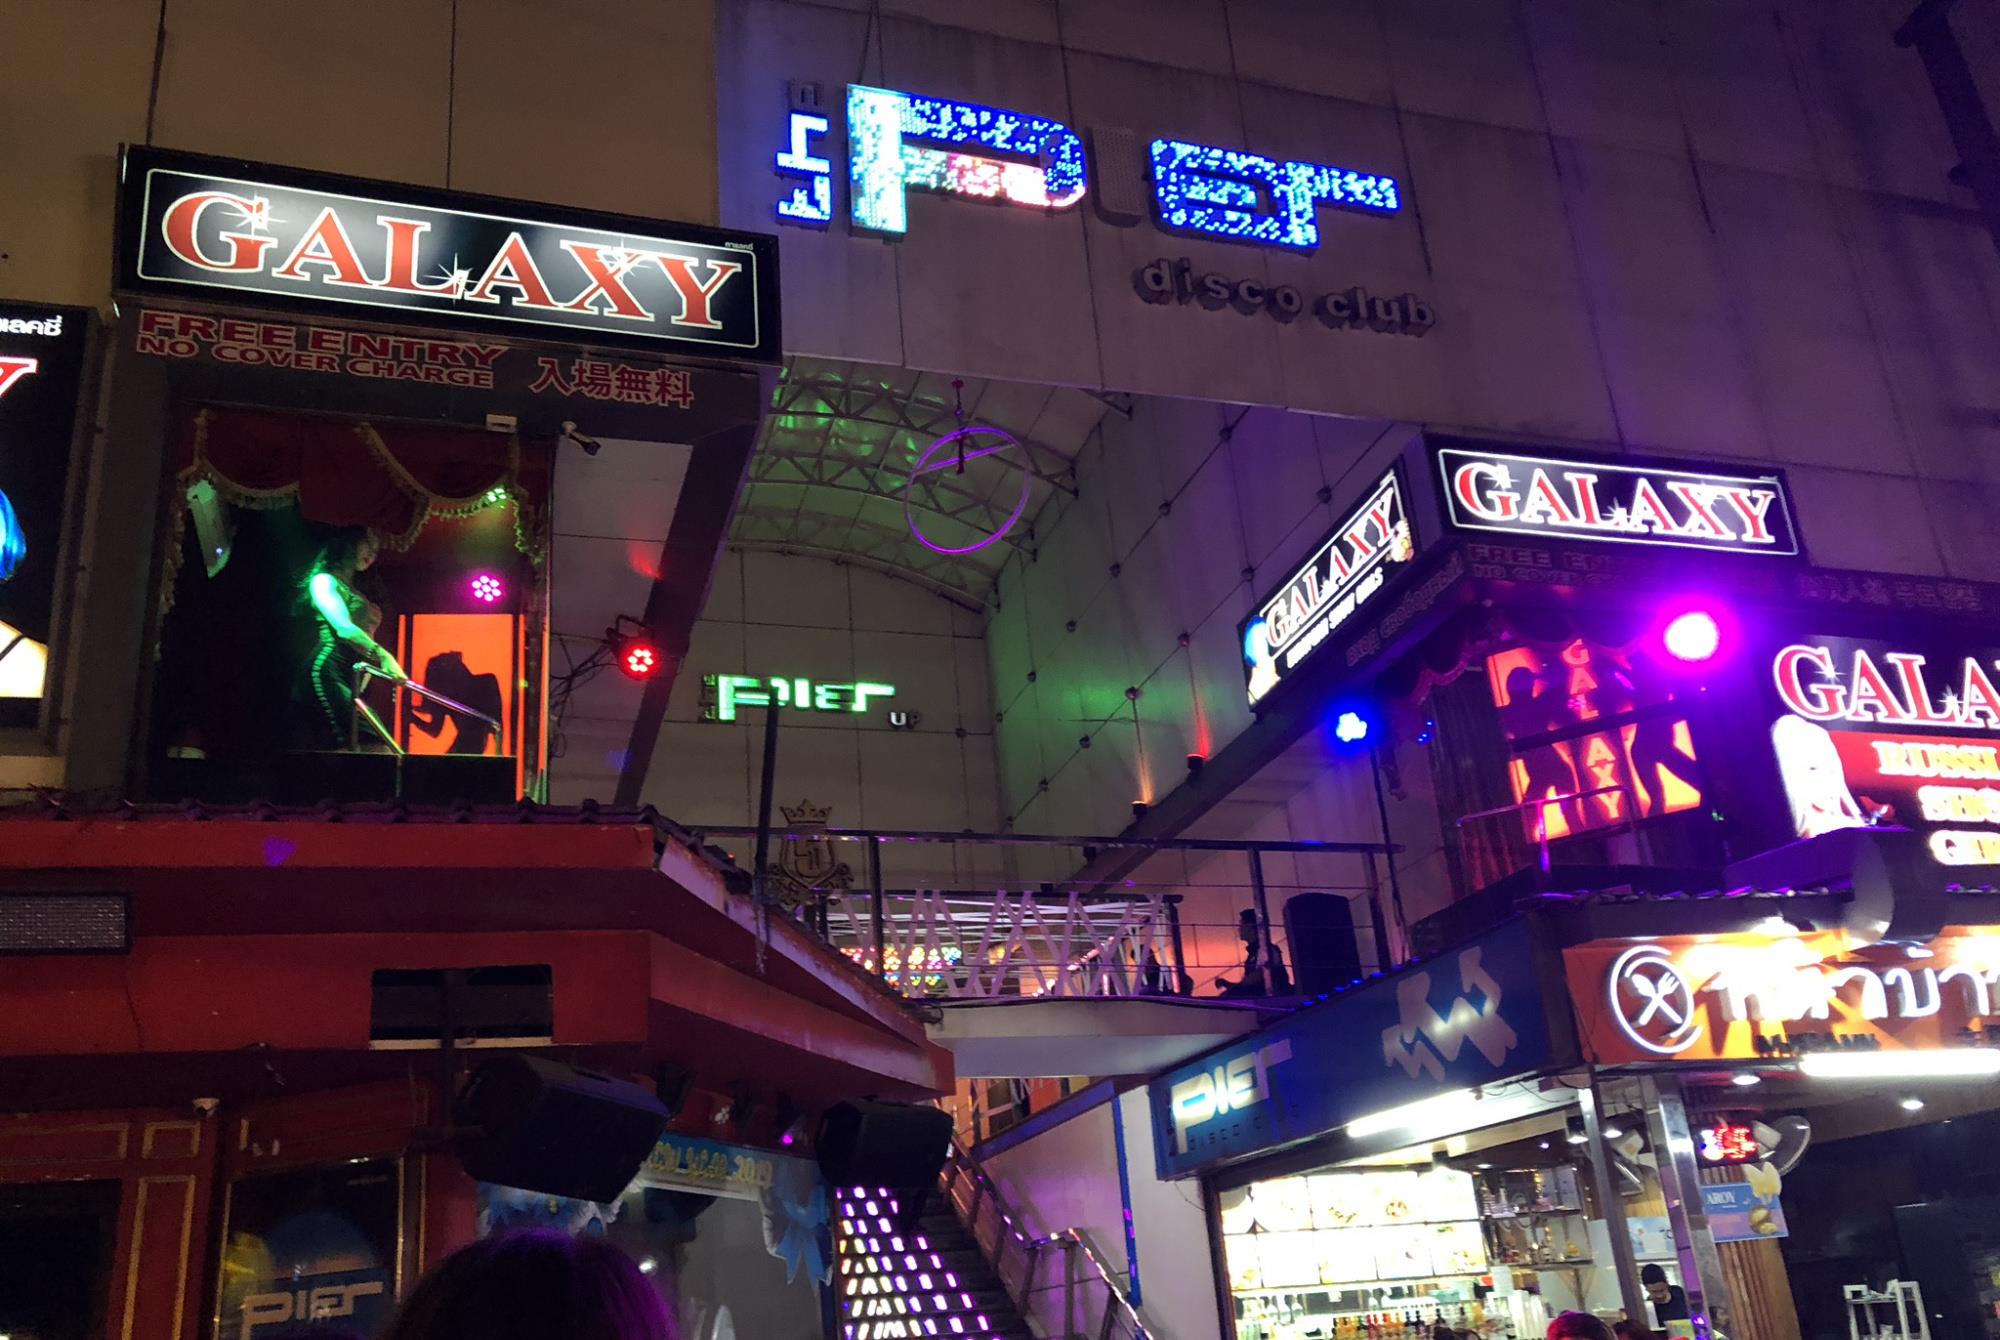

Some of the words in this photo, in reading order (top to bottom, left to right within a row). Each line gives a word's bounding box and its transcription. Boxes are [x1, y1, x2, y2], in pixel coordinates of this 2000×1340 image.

[161, 191, 743, 330] GALAXY
[1142, 257, 1302, 316] disco
[1324, 286, 1437, 327] club
[136, 334, 199, 358] NO
[211, 343, 340, 374] COVER
[346, 358, 494, 389] CHARGE
[138, 309, 297, 350] FREE
[308, 327, 510, 369] ENTRY
[529, 356, 696, 409] 入場無料
[1455, 463, 1776, 544] GALAXY
[1264, 486, 1394, 648] GALAXY
[1467, 543, 1553, 569] FREE
[1773, 643, 2000, 729] GALA
